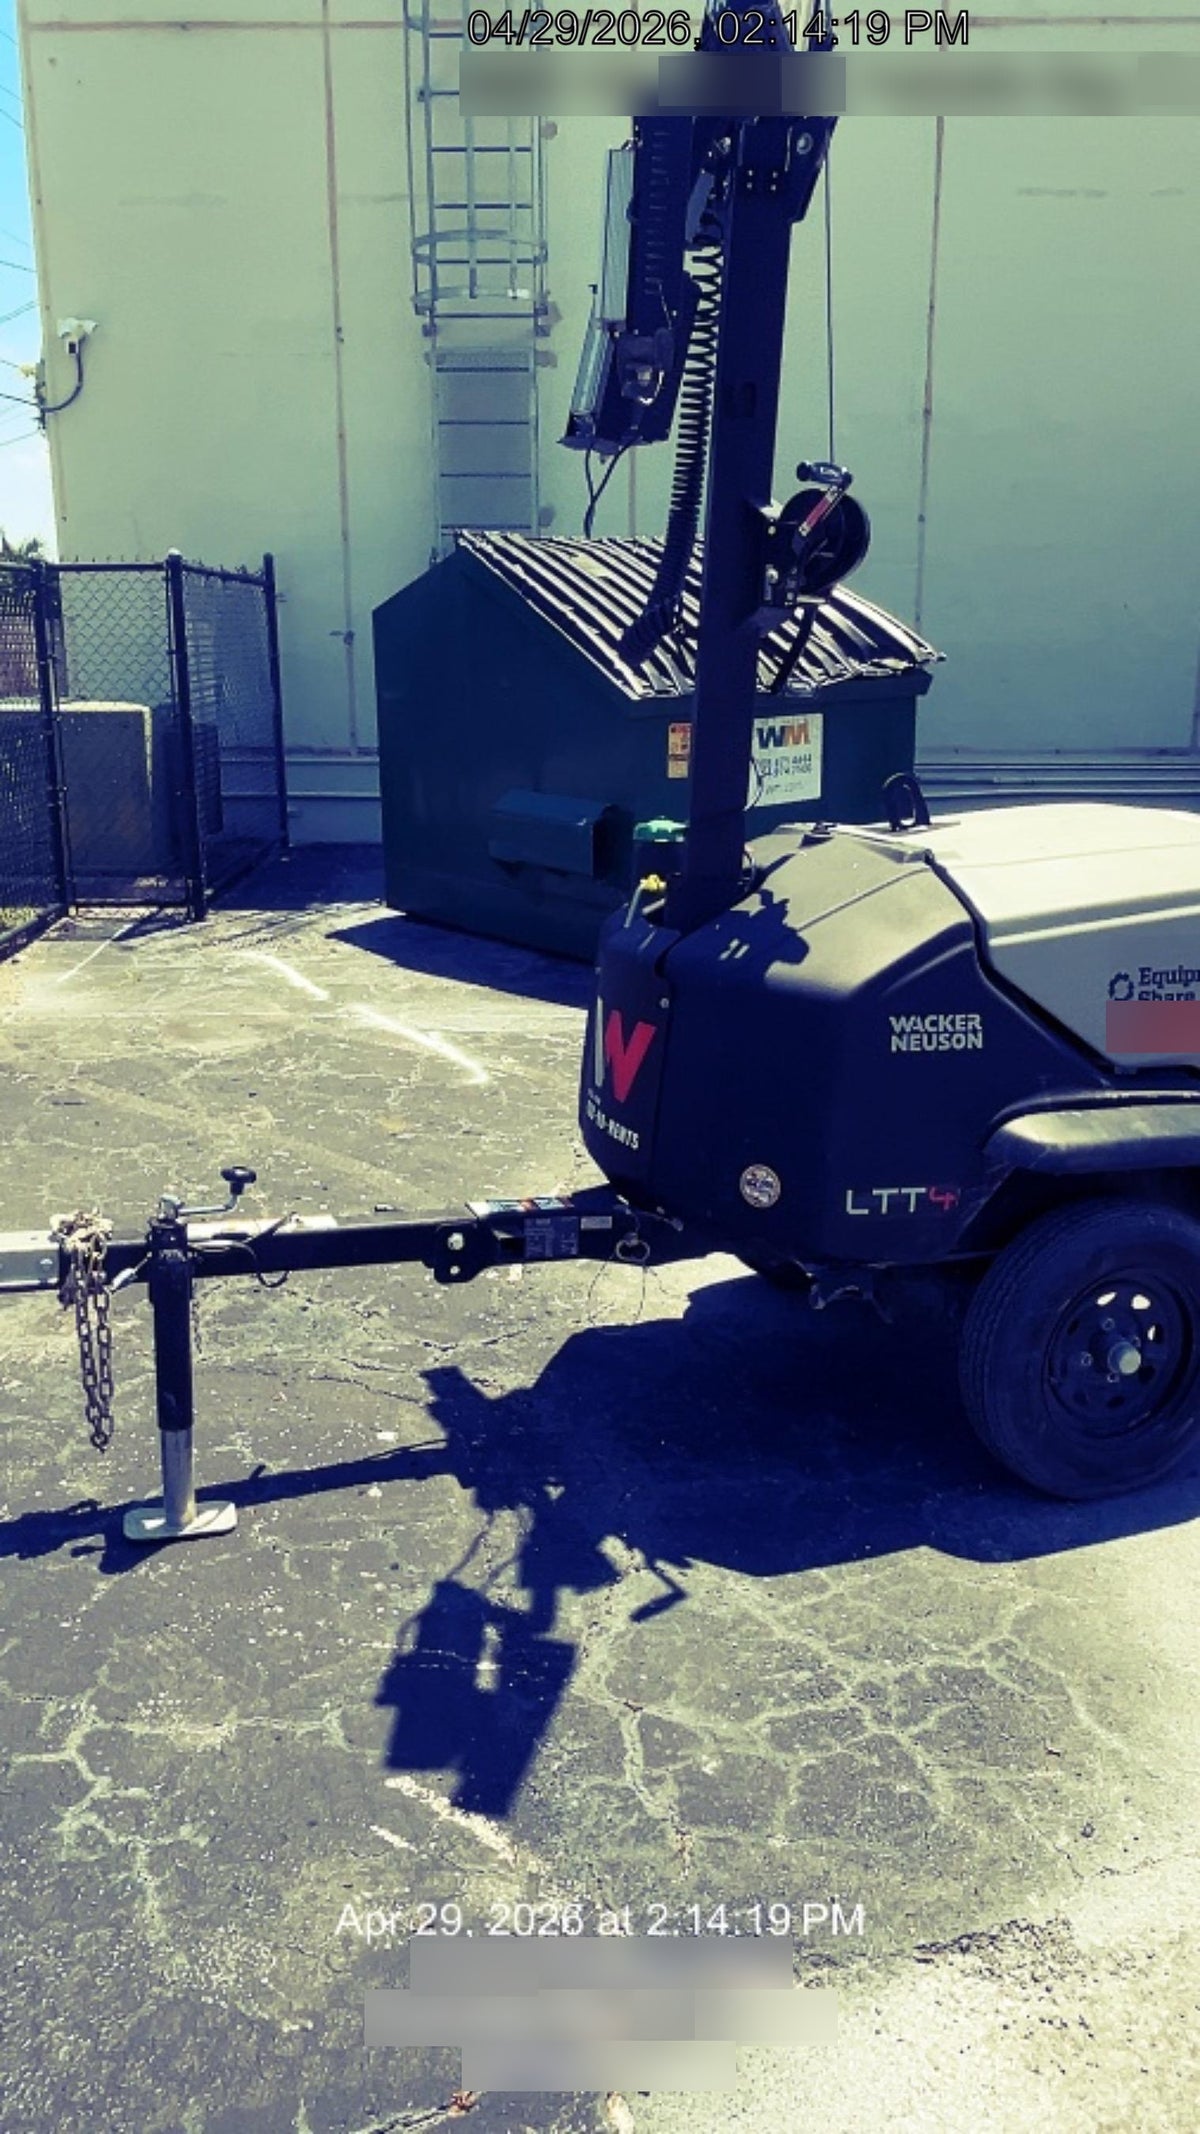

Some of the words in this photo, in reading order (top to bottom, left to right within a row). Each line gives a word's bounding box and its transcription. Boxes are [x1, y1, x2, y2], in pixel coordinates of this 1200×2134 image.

[755, 724, 811, 749] WM
[889, 1014, 982, 1033] WACKER
[890, 1032, 984, 1053] NEUSON
[845, 1186, 957, 1215] LTT4
